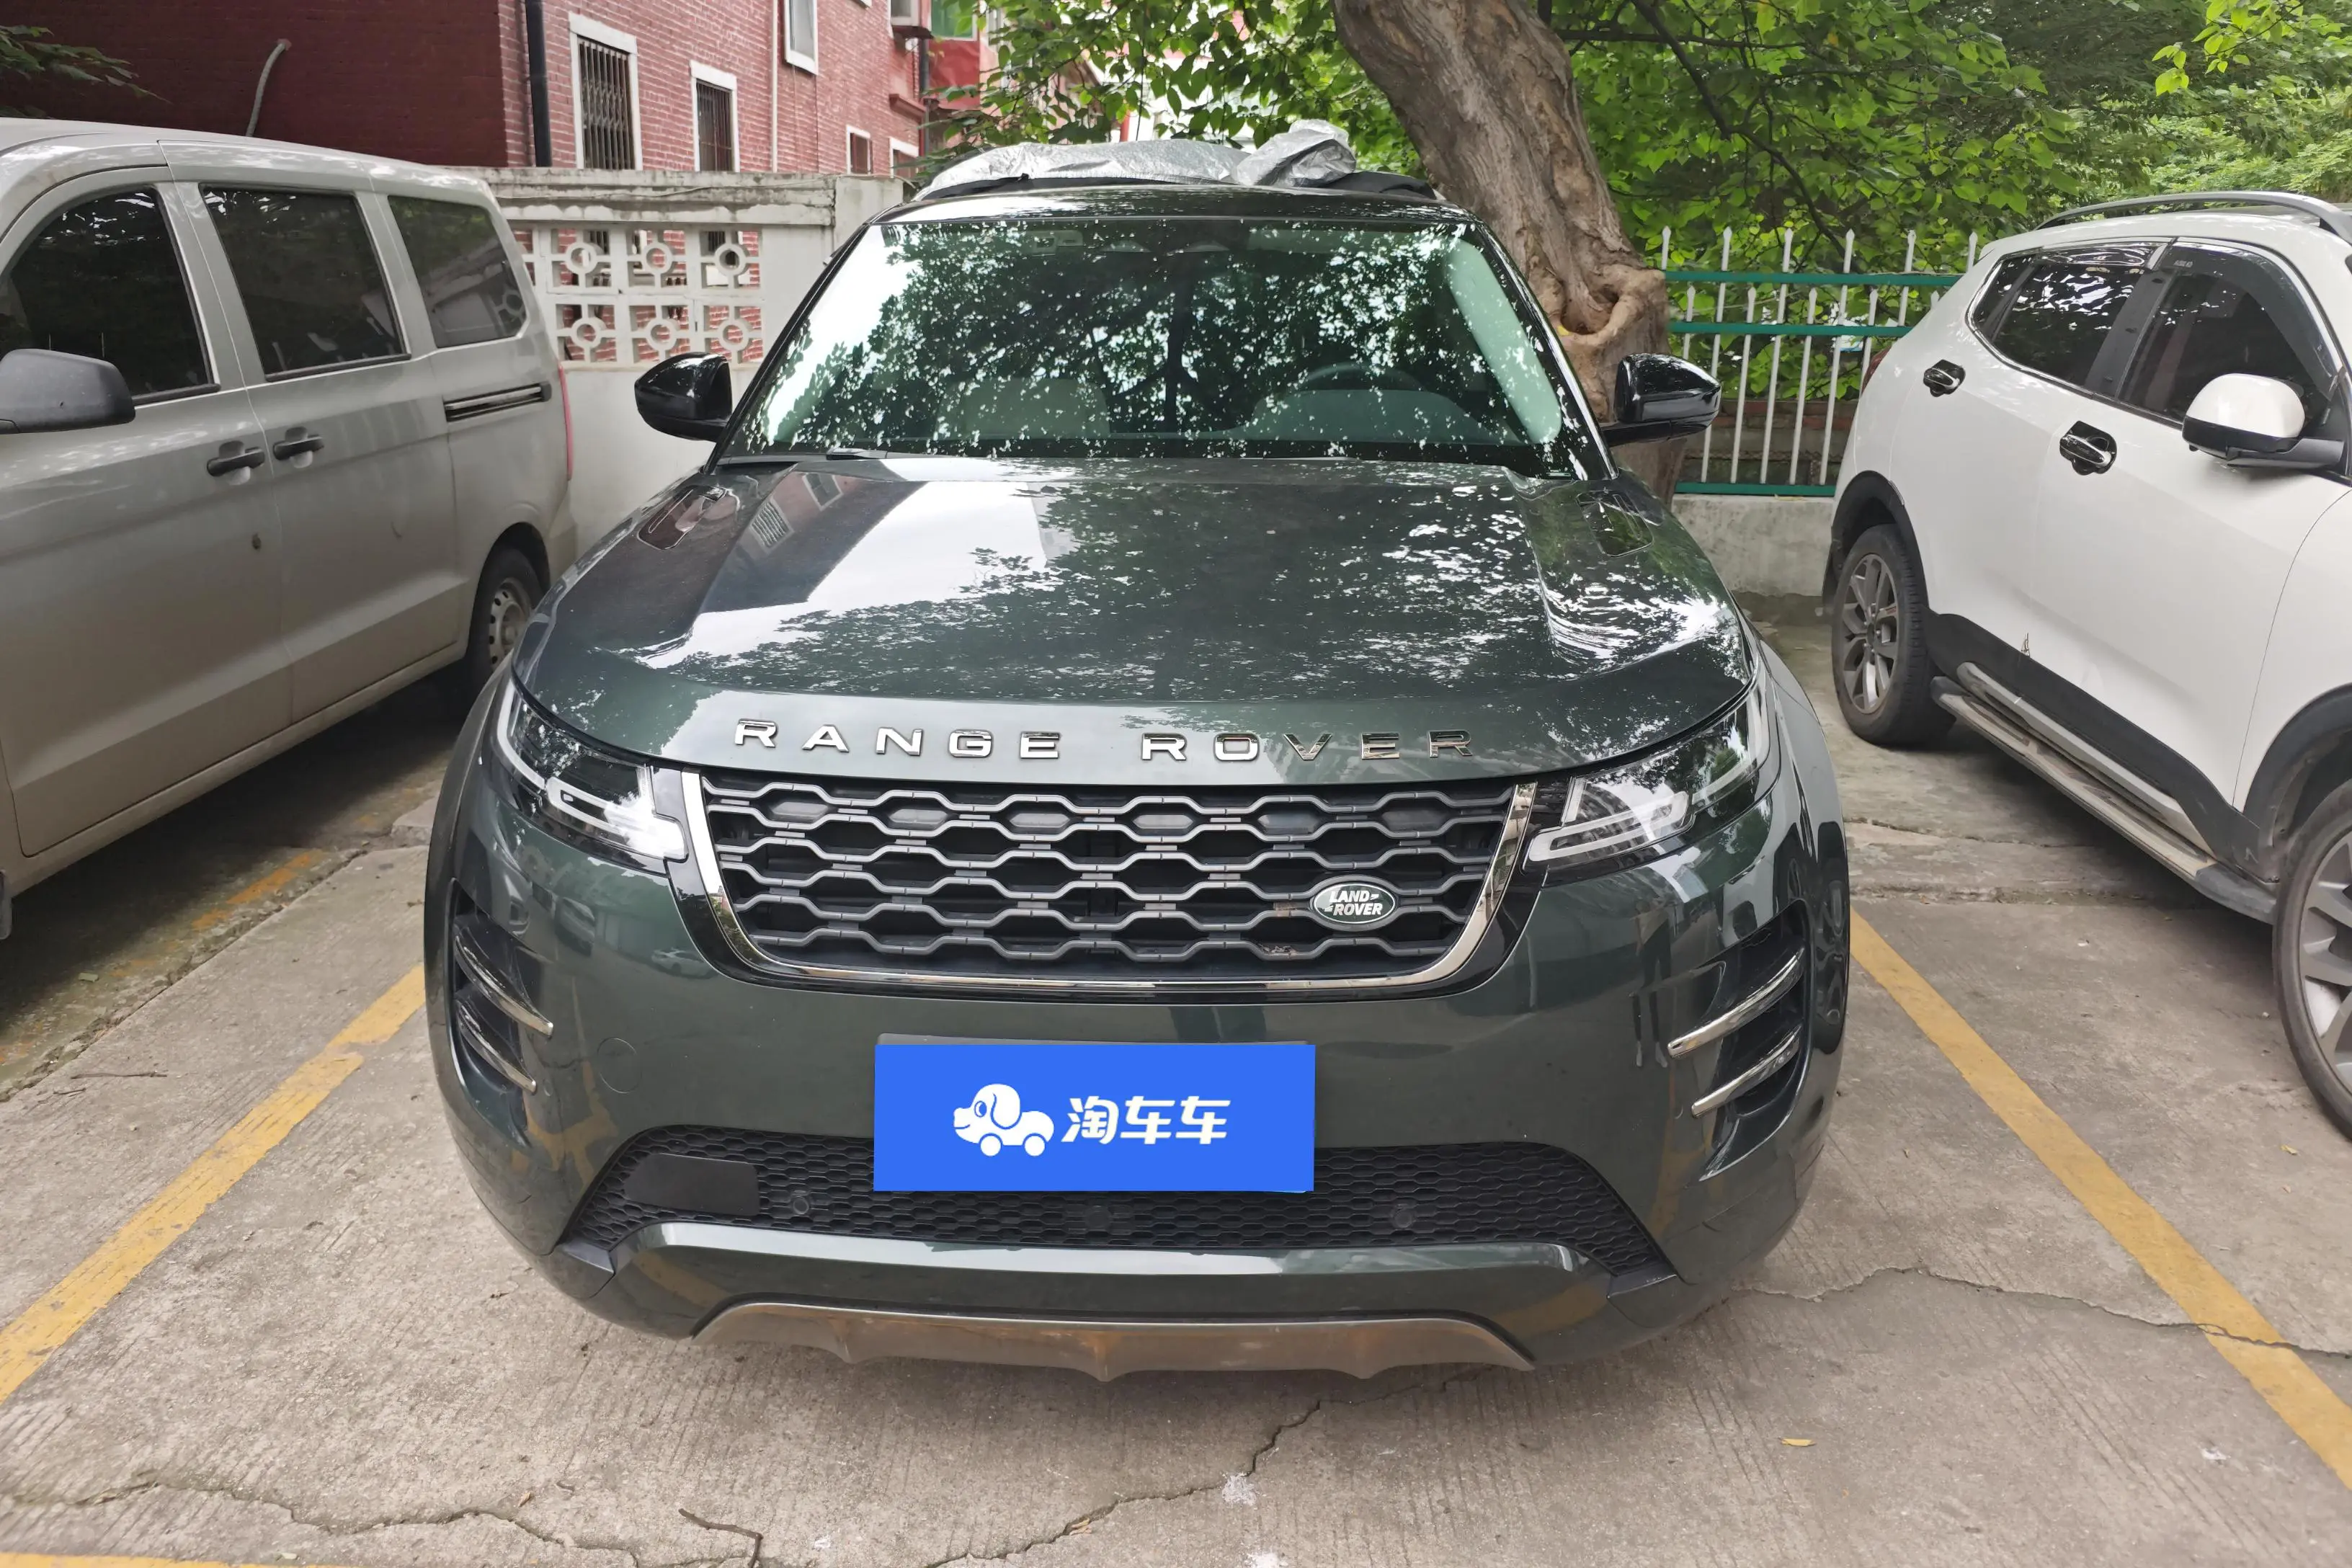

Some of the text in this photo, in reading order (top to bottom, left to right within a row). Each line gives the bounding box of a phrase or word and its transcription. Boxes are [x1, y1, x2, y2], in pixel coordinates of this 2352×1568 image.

[734, 718, 1474, 762] RANGE ROVER
[1329, 890, 1371, 903] LAND
[1333, 902, 1384, 917] ROVER
